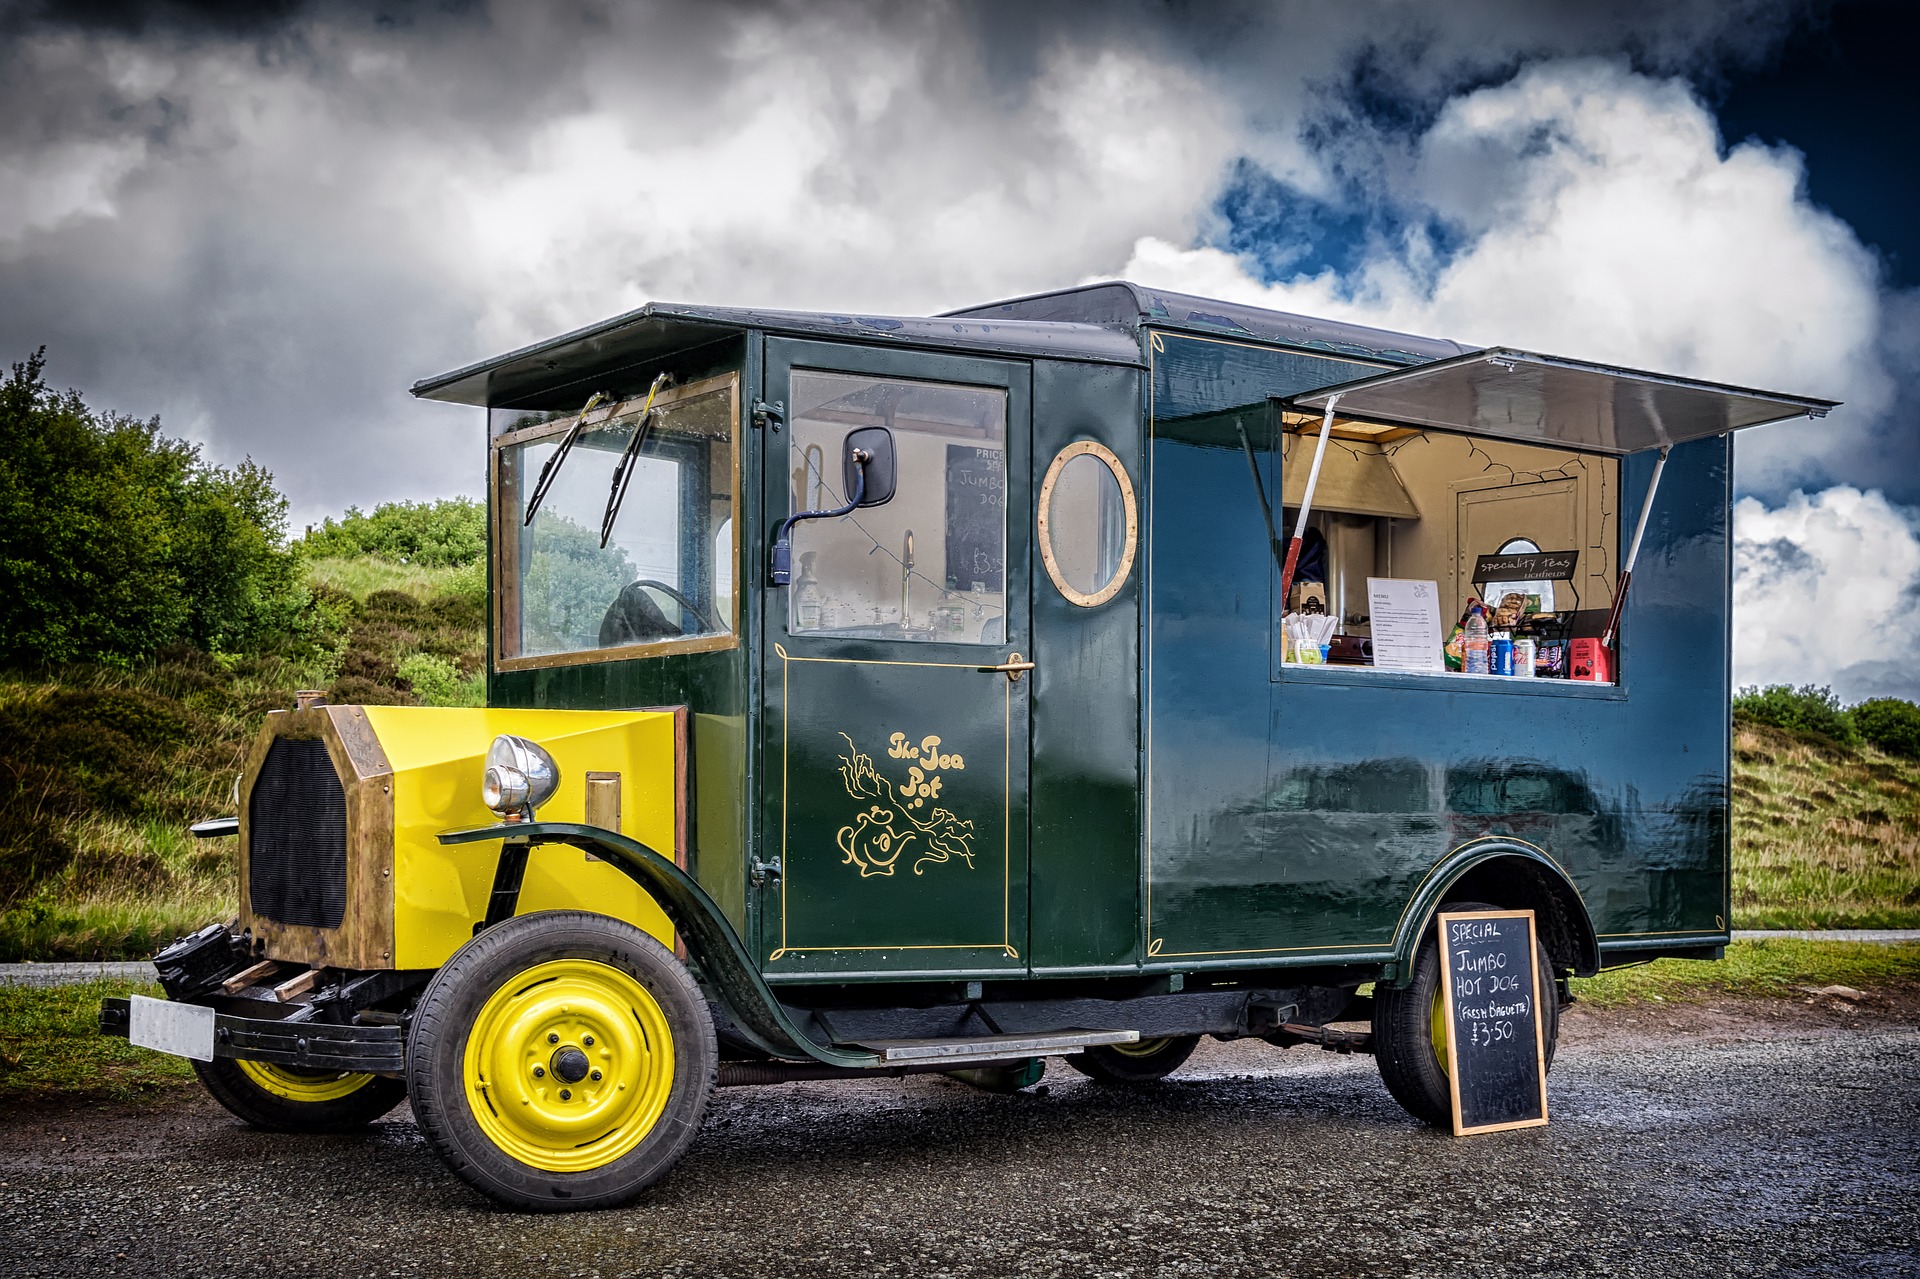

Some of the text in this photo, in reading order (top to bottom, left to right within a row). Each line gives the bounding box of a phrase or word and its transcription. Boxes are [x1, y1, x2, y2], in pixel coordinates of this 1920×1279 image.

[1481, 557, 1570, 572] speciality teas
[1490, 644, 1498, 671] pepsi
[888, 732, 965, 771] The Tea
[900, 766, 942, 799] Pot
[1452, 922, 1501, 942] SPECIAL
[1456, 949, 1507, 973] JUMBO
[1456, 974, 1520, 998] HOT DOG
